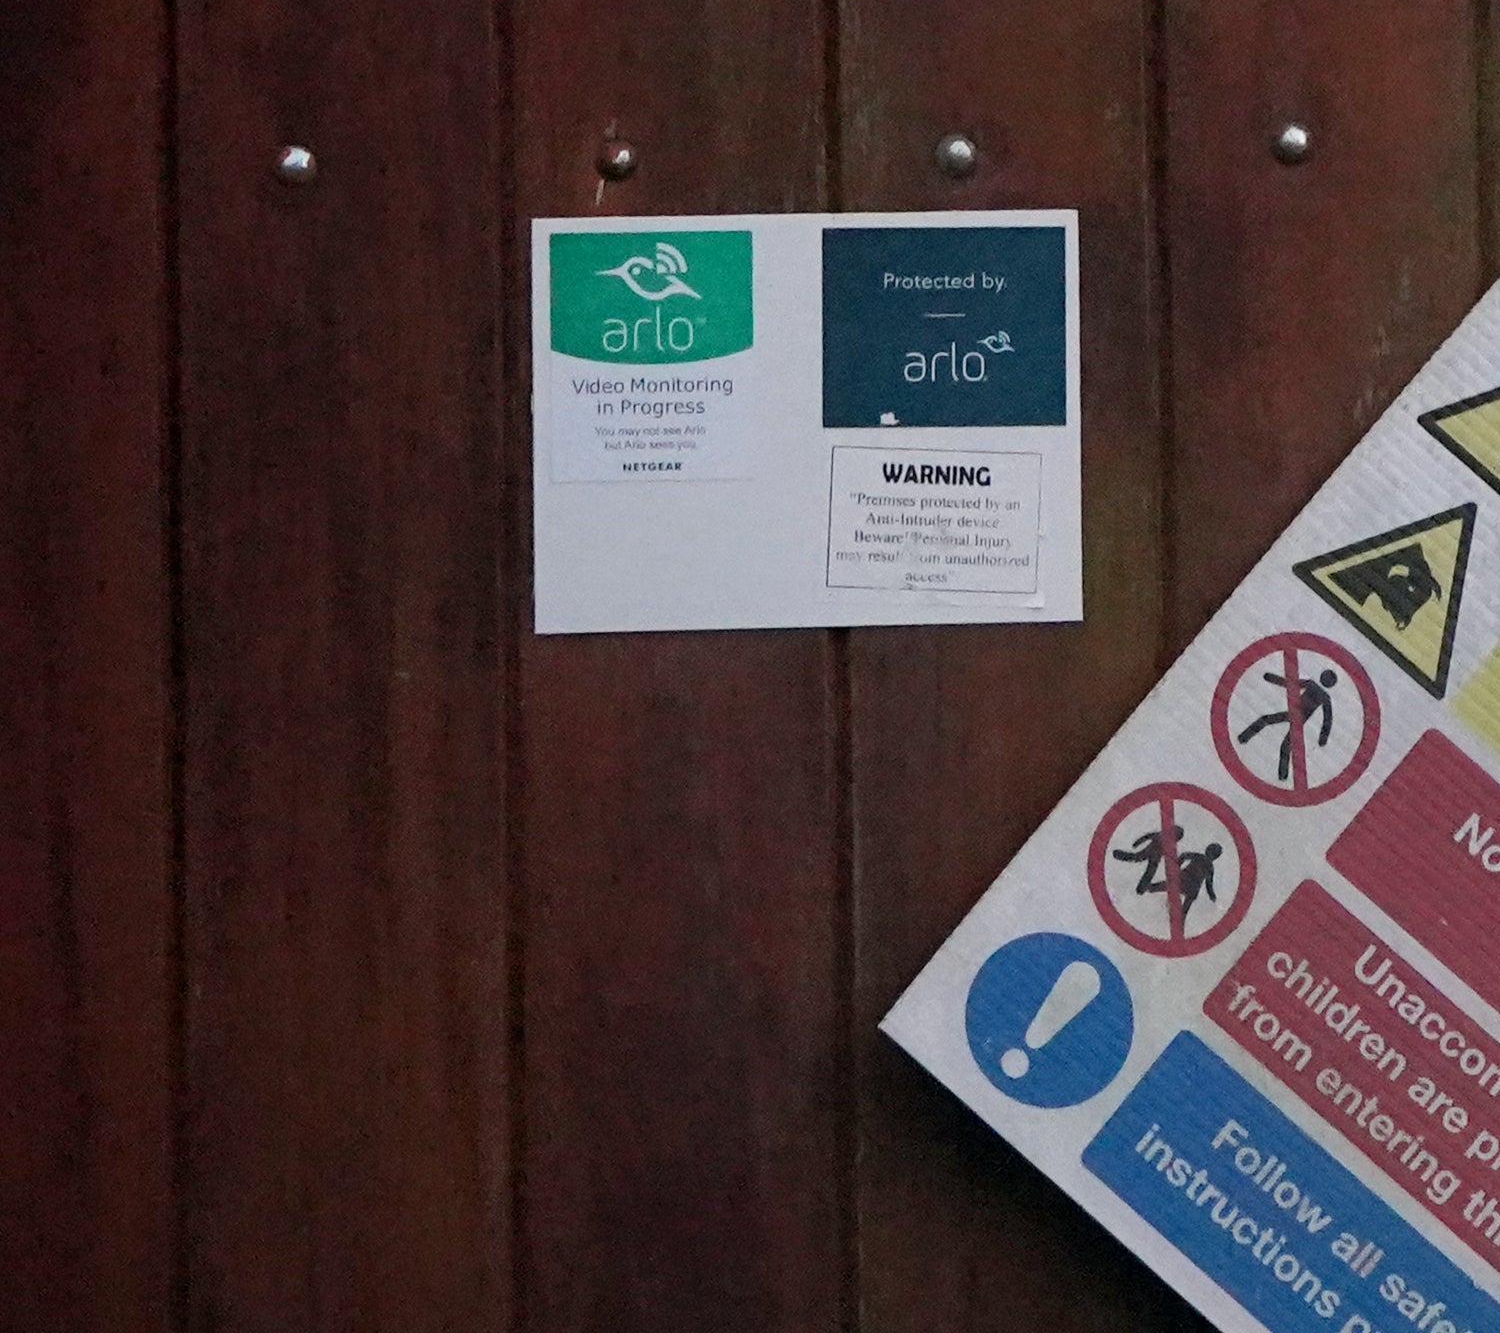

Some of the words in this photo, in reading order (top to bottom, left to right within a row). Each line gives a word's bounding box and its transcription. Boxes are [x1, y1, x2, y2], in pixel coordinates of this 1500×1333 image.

[883, 272, 976, 290] Protected
[904, 341, 986, 383] arlo
[572, 378, 625, 395] Video
[630, 377, 734, 395] Monitoring
[597, 400, 614, 415] in
[621, 399, 706, 419] Progress
[623, 462, 682, 472] NETGEAR
[882, 462, 991, 487] WARNING
[920, 496, 981, 512] protected
[984, 497, 1001, 513] by
[865, 512, 952, 528] Anti-Intruder
[868, 549, 900, 563] resul
[1266, 949, 1408, 1084] children
[1407, 1073, 1470, 1135] are
[1227, 983, 1315, 1072] from
[1315, 1066, 1464, 1206] entering
[1133, 1123, 1343, 1321] instructions
[1210, 1118, 1335, 1235] Follow
[1330, 1231, 1386, 1279] all
[1379, 1274, 1476, 1333] saf
